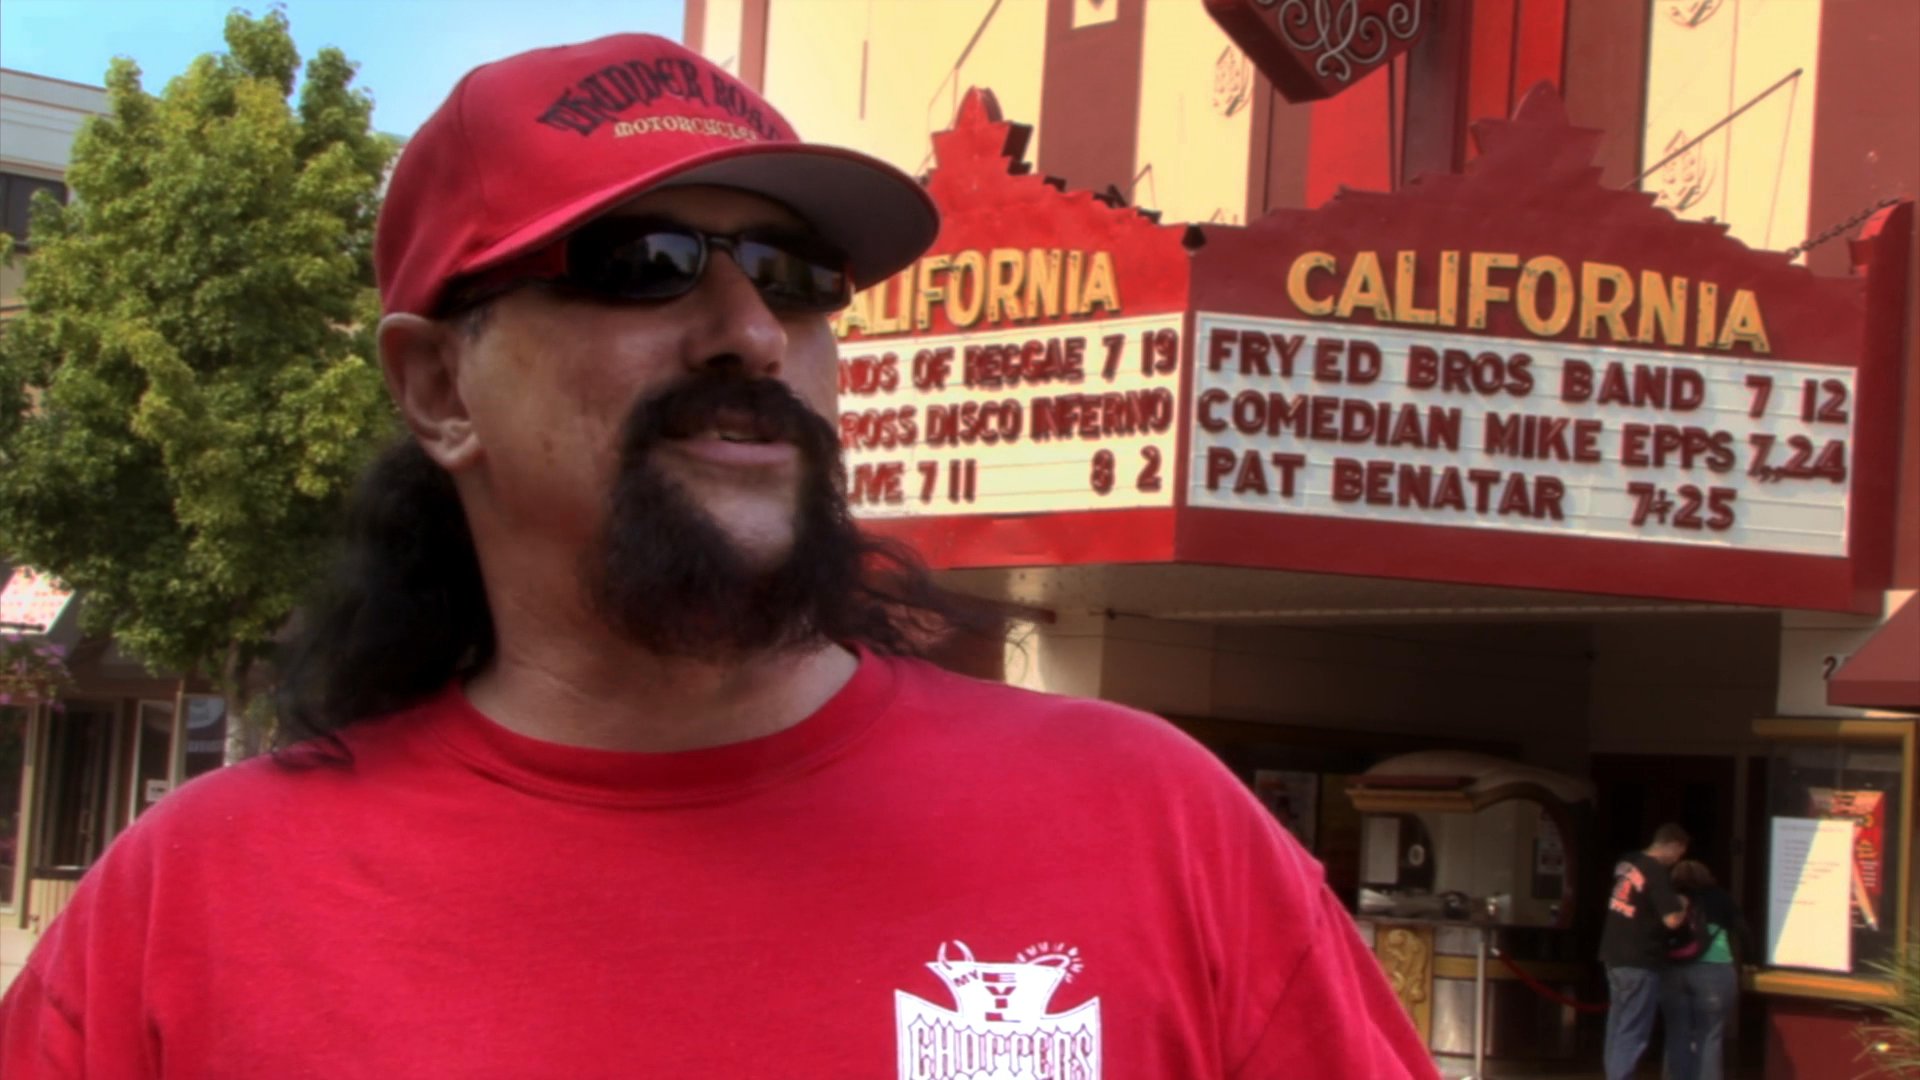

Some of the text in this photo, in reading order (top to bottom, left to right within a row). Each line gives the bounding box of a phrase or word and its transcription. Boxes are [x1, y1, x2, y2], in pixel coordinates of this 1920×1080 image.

[828, 248, 1120, 338] ALIFORNIA
[1287, 250, 1770, 353] CALIFORNIA
[913, 347, 955, 392] OF
[963, 336, 1086, 388] REGGAE
[1102, 334, 1126, 381] 7
[1142, 328, 1180, 377] 19
[1406, 345, 1535, 398] BROS
[1560, 358, 1705, 413] BAND
[1745, 374, 1773, 419] 7
[1801, 379, 1850, 425] 12
[925, 398, 1024, 447] DISCO
[1029, 387, 1175, 443] INFERNO
[1197, 387, 1463, 453] COMEDIAN
[1484, 411, 1602, 466] MIKE
[1620, 423, 1737, 475] EPPS
[848, 445, 1163, 505] IVE 7 11 8 2
[1206, 446, 1306, 498] PAT
[1332, 457, 1566, 521] BENATAR
[907, 1012, 1094, 1080] CHOPPERS
